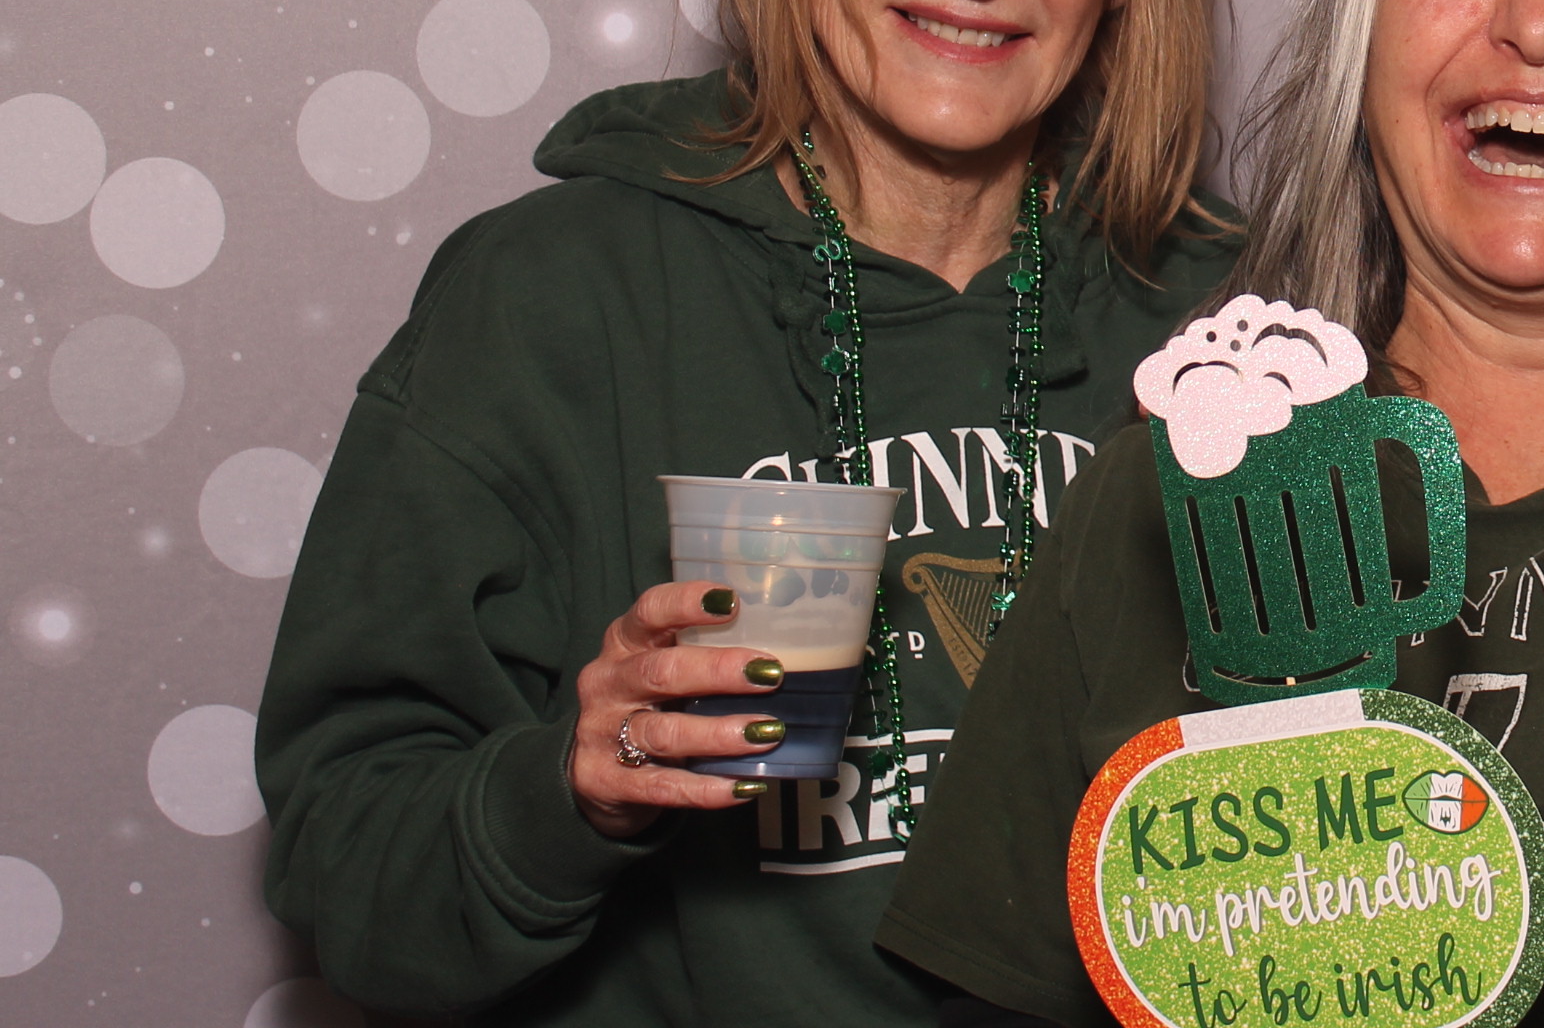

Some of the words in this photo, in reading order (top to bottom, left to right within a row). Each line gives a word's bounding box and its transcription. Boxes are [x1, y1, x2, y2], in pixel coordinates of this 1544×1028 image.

[757, 752, 946, 851] IRE
[1128, 785, 1292, 875] KISS
[1314, 767, 1404, 852] ME
[1214, 841, 1502, 957] pretending
[1179, 962, 1247, 1028] to
[1258, 955, 1322, 1026] be
[1333, 932, 1482, 1019] irish
